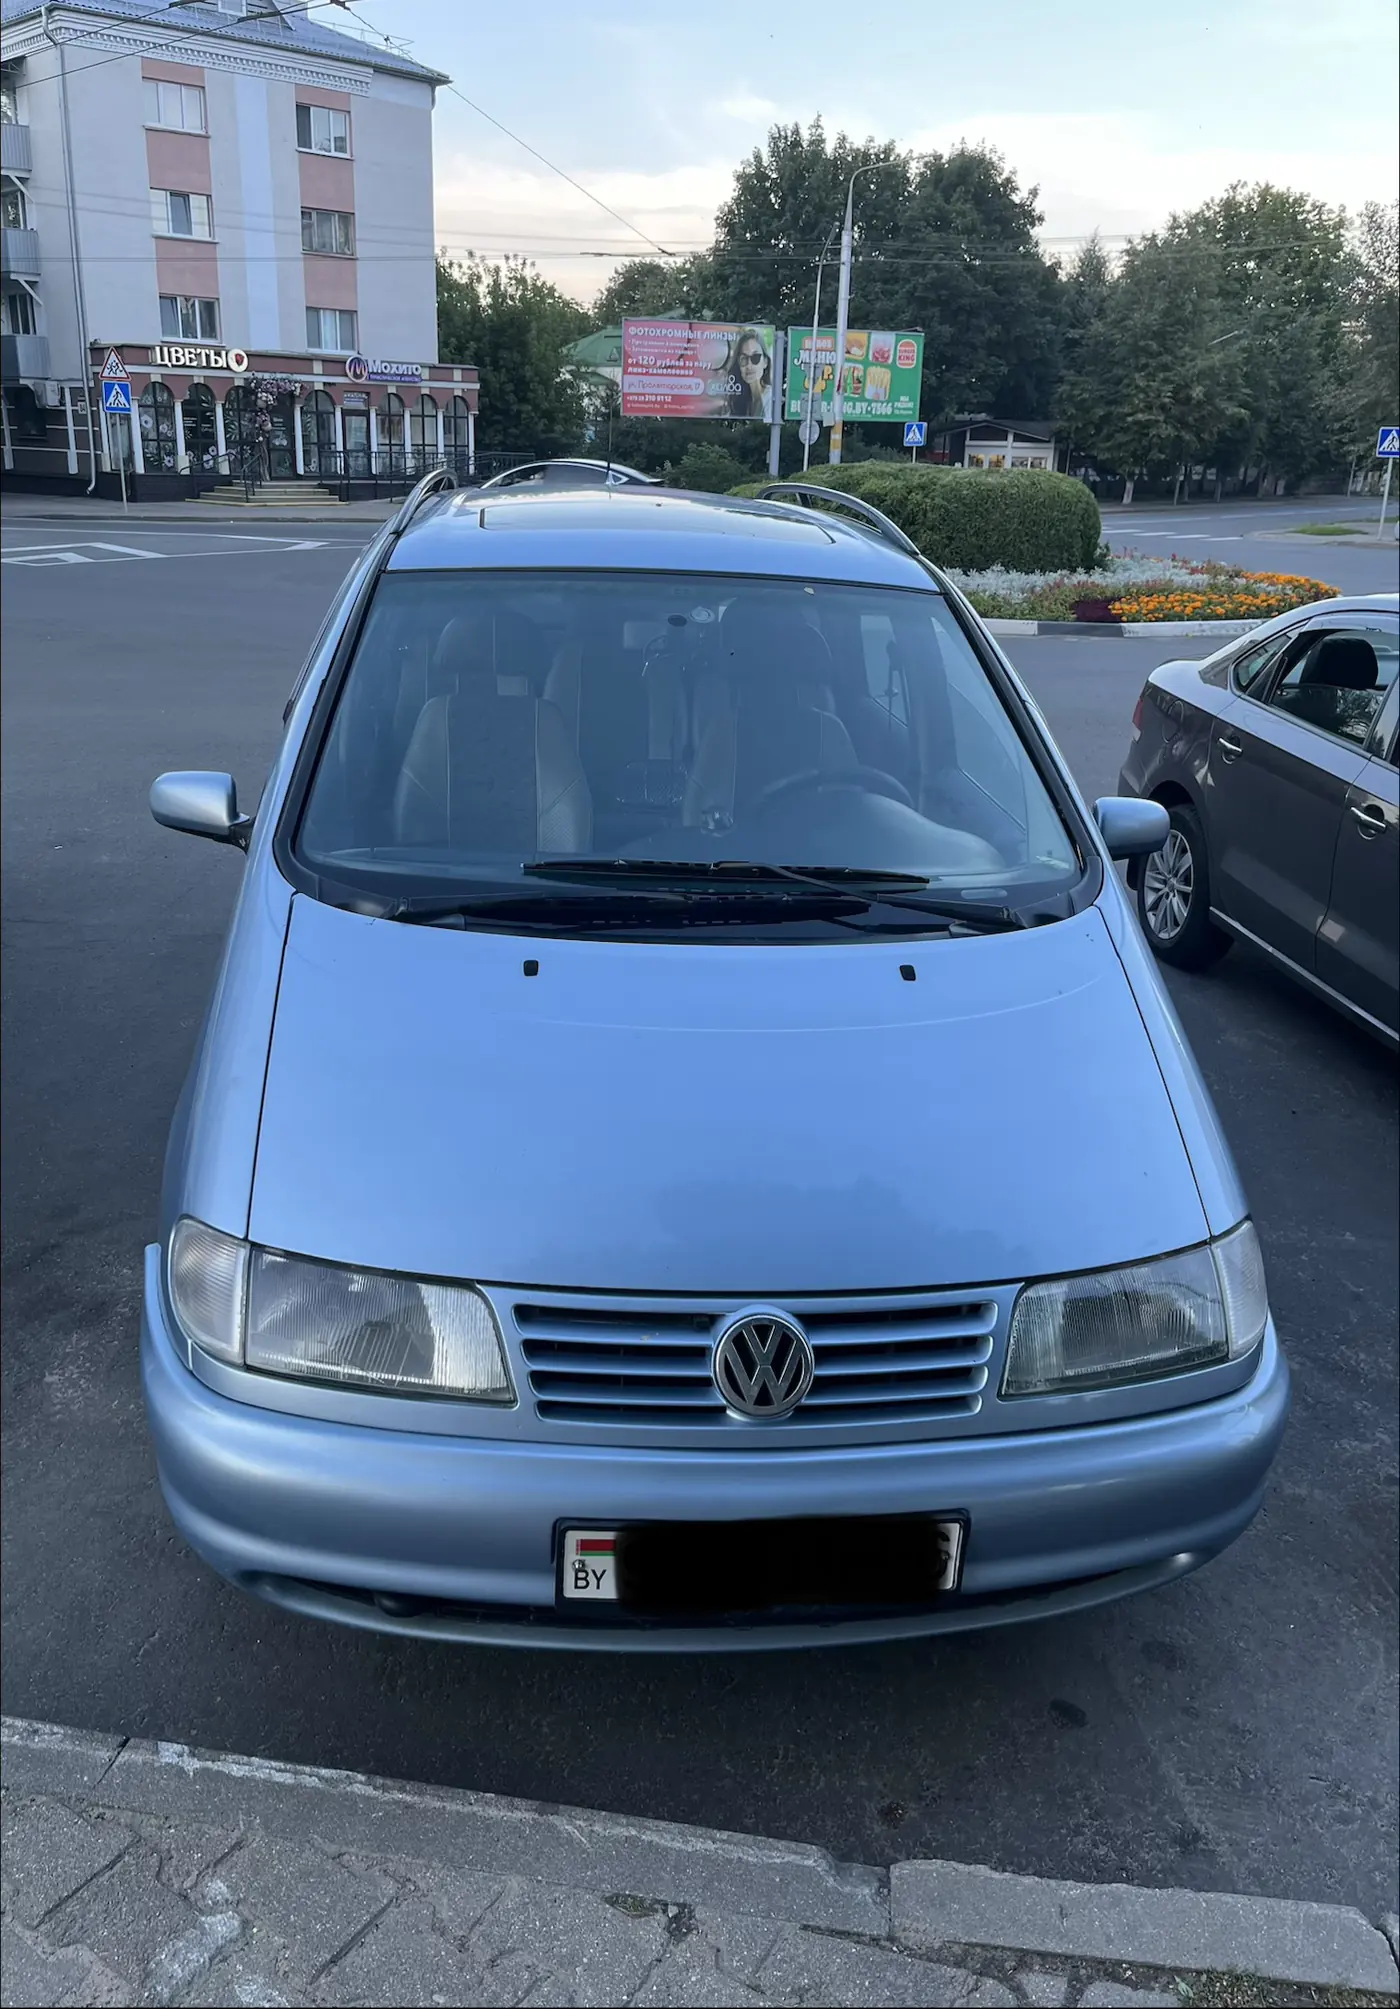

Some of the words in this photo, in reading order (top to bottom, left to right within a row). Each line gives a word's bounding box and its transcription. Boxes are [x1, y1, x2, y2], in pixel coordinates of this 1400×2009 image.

[628, 326, 701, 339] ФОТОХРОМНЫЕ
[703, 330, 736, 341] ЛИНЗЫ
[154, 346, 227, 368] ЦВЕТЫ
[638, 355, 655, 365] 120
[656, 358, 684, 367] рублей
[898, 354, 915, 362] KING
[573, 1569, 607, 1590] BY
